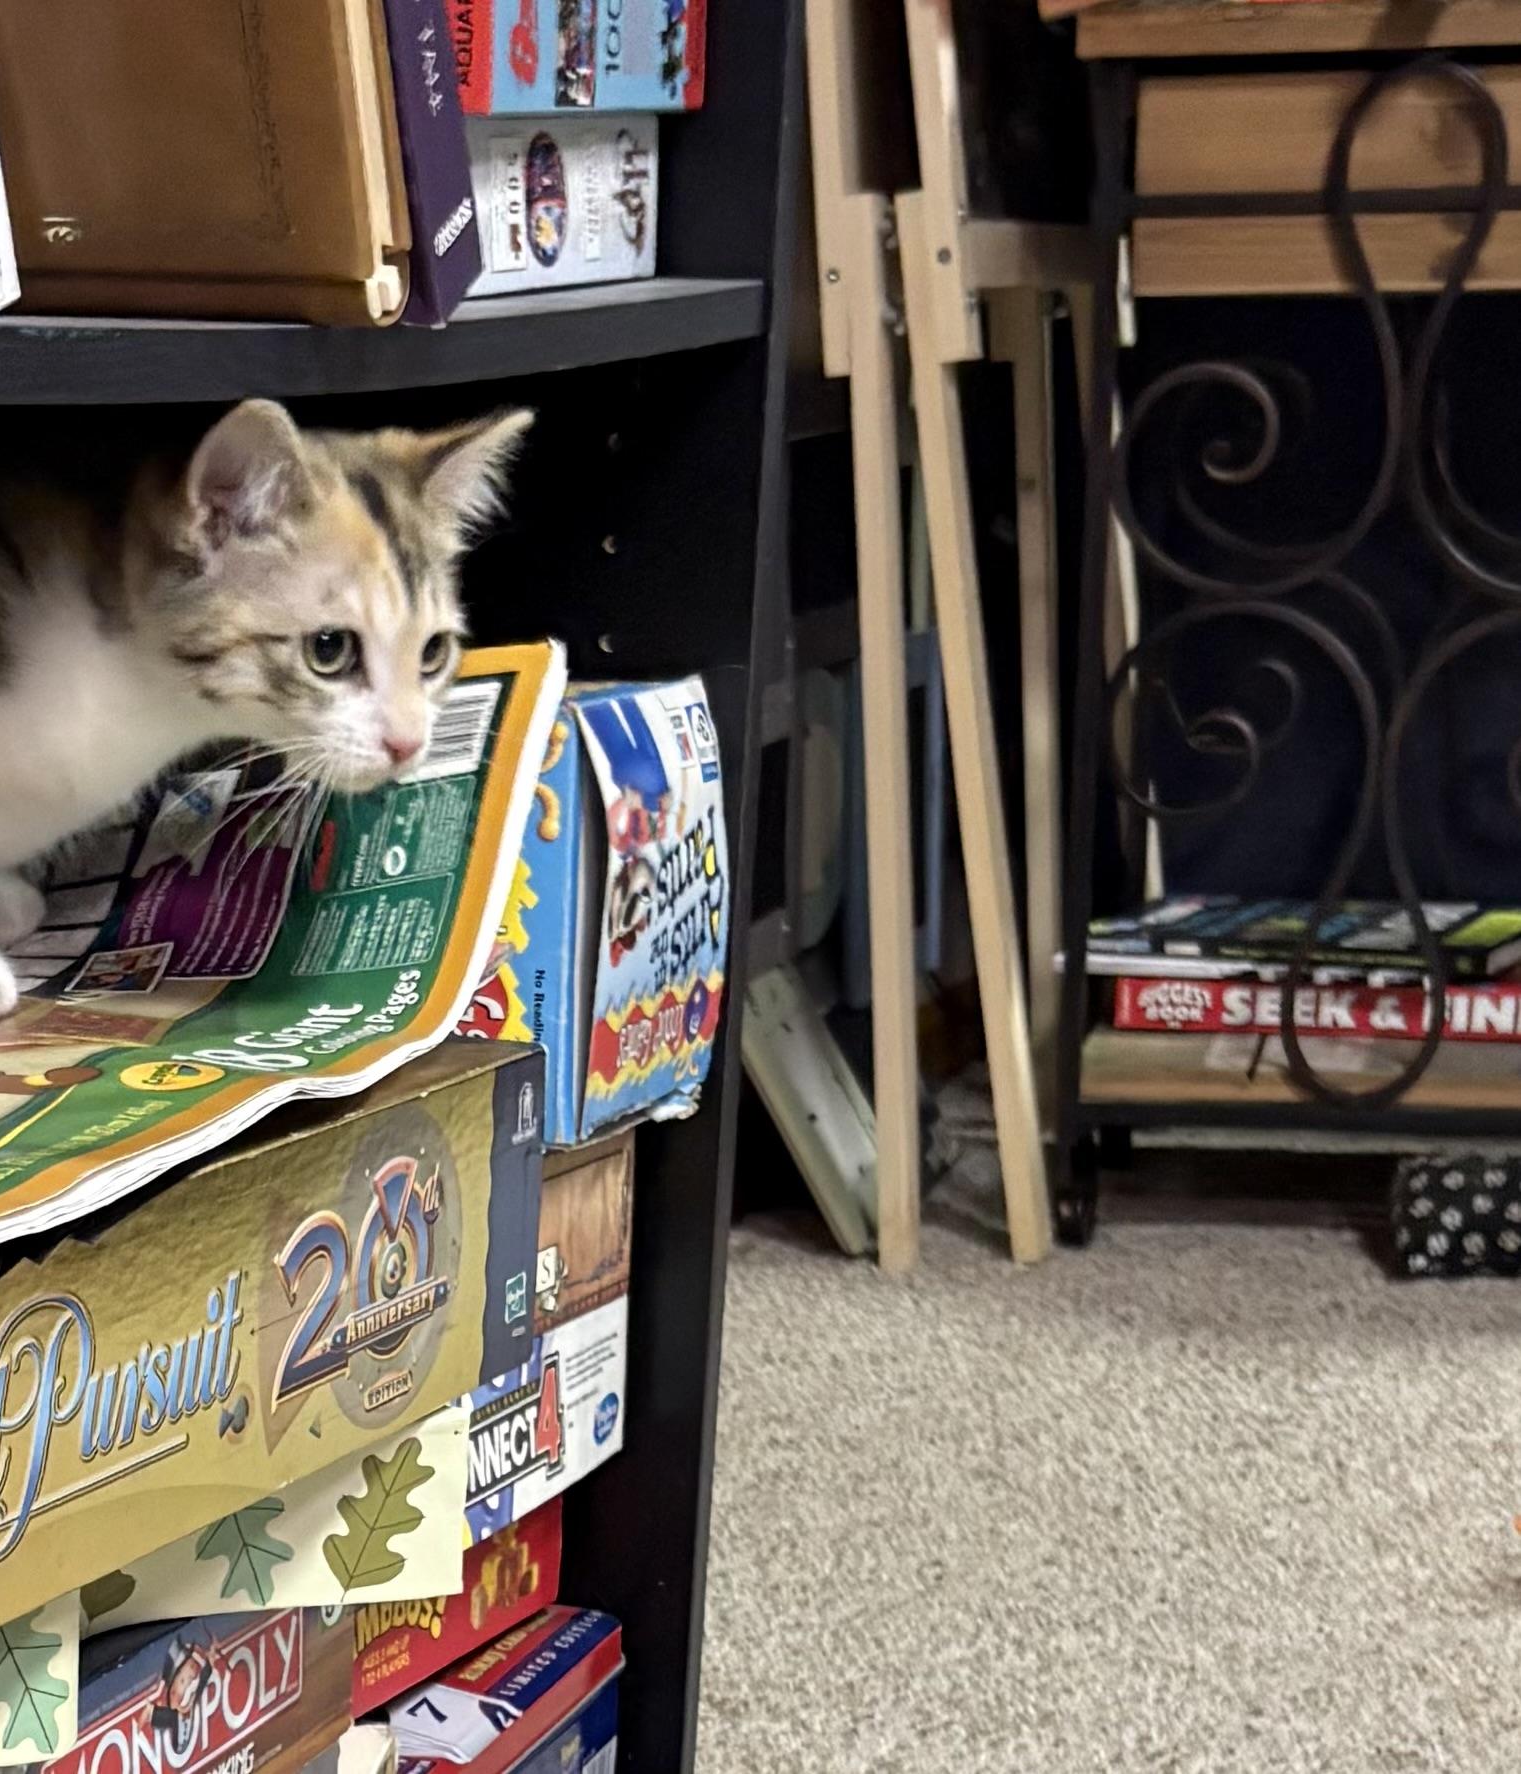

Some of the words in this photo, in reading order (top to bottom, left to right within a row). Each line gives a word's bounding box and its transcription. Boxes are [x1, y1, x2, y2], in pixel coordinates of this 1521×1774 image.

[456, 0, 473, 87] AQUA
[365, 969, 422, 1025] Pages
[1220, 985, 1357, 1029] SEEK
[1367, 995, 1408, 1031] &
[233, 1003, 364, 1048] Giant
[171, 1049, 309, 1072] 18
[346, 1286, 435, 1346] Anniversary
[367, 1377, 410, 1406] EDITION
[535, 1366, 562, 1464] 4
[500, 1651, 557, 1696] LIMITED
[554, 1609, 605, 1649] EDITION
[50, 1613, 298, 1774] ONOPOLY
[407, 1697, 448, 1723] 7
